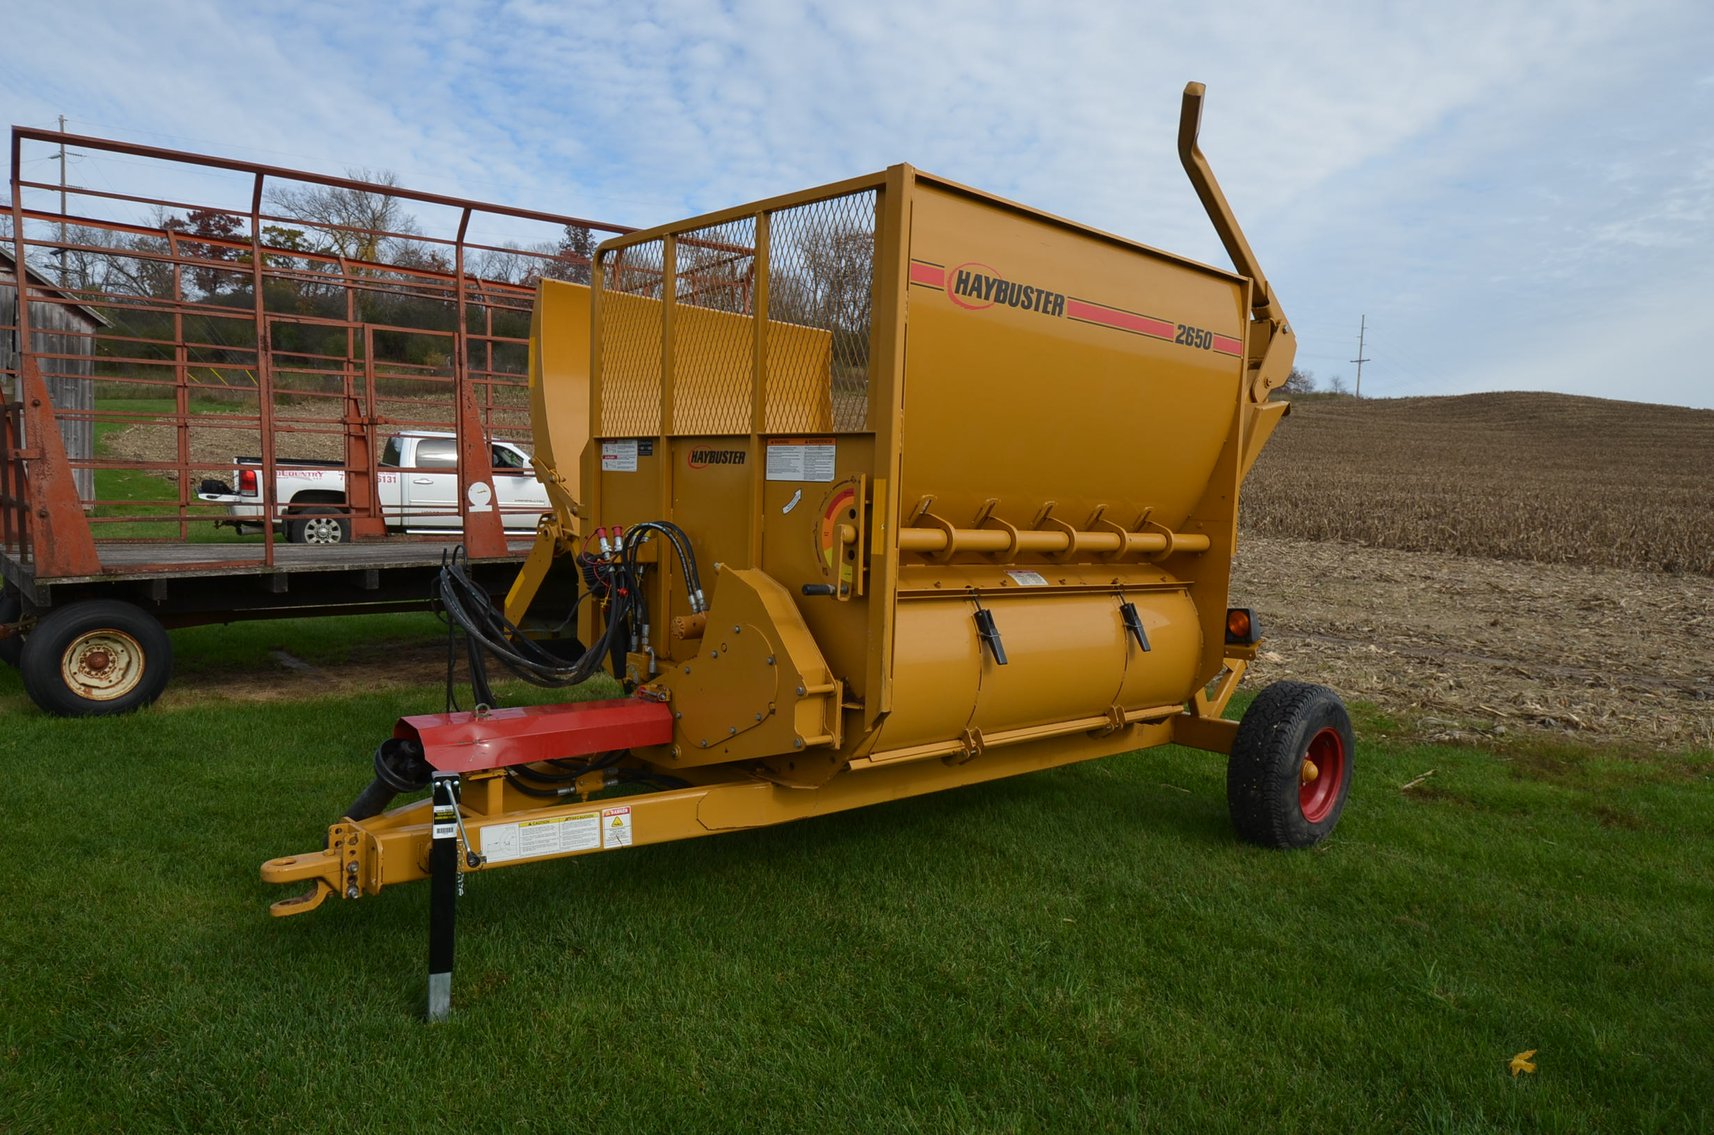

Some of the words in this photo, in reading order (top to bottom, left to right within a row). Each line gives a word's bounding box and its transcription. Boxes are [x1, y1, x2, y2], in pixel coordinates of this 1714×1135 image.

[954, 269, 1065, 317] HAYBUSTER
[1175, 324, 1212, 350] 2650
[690, 450, 746, 465] HAYBUSTER
